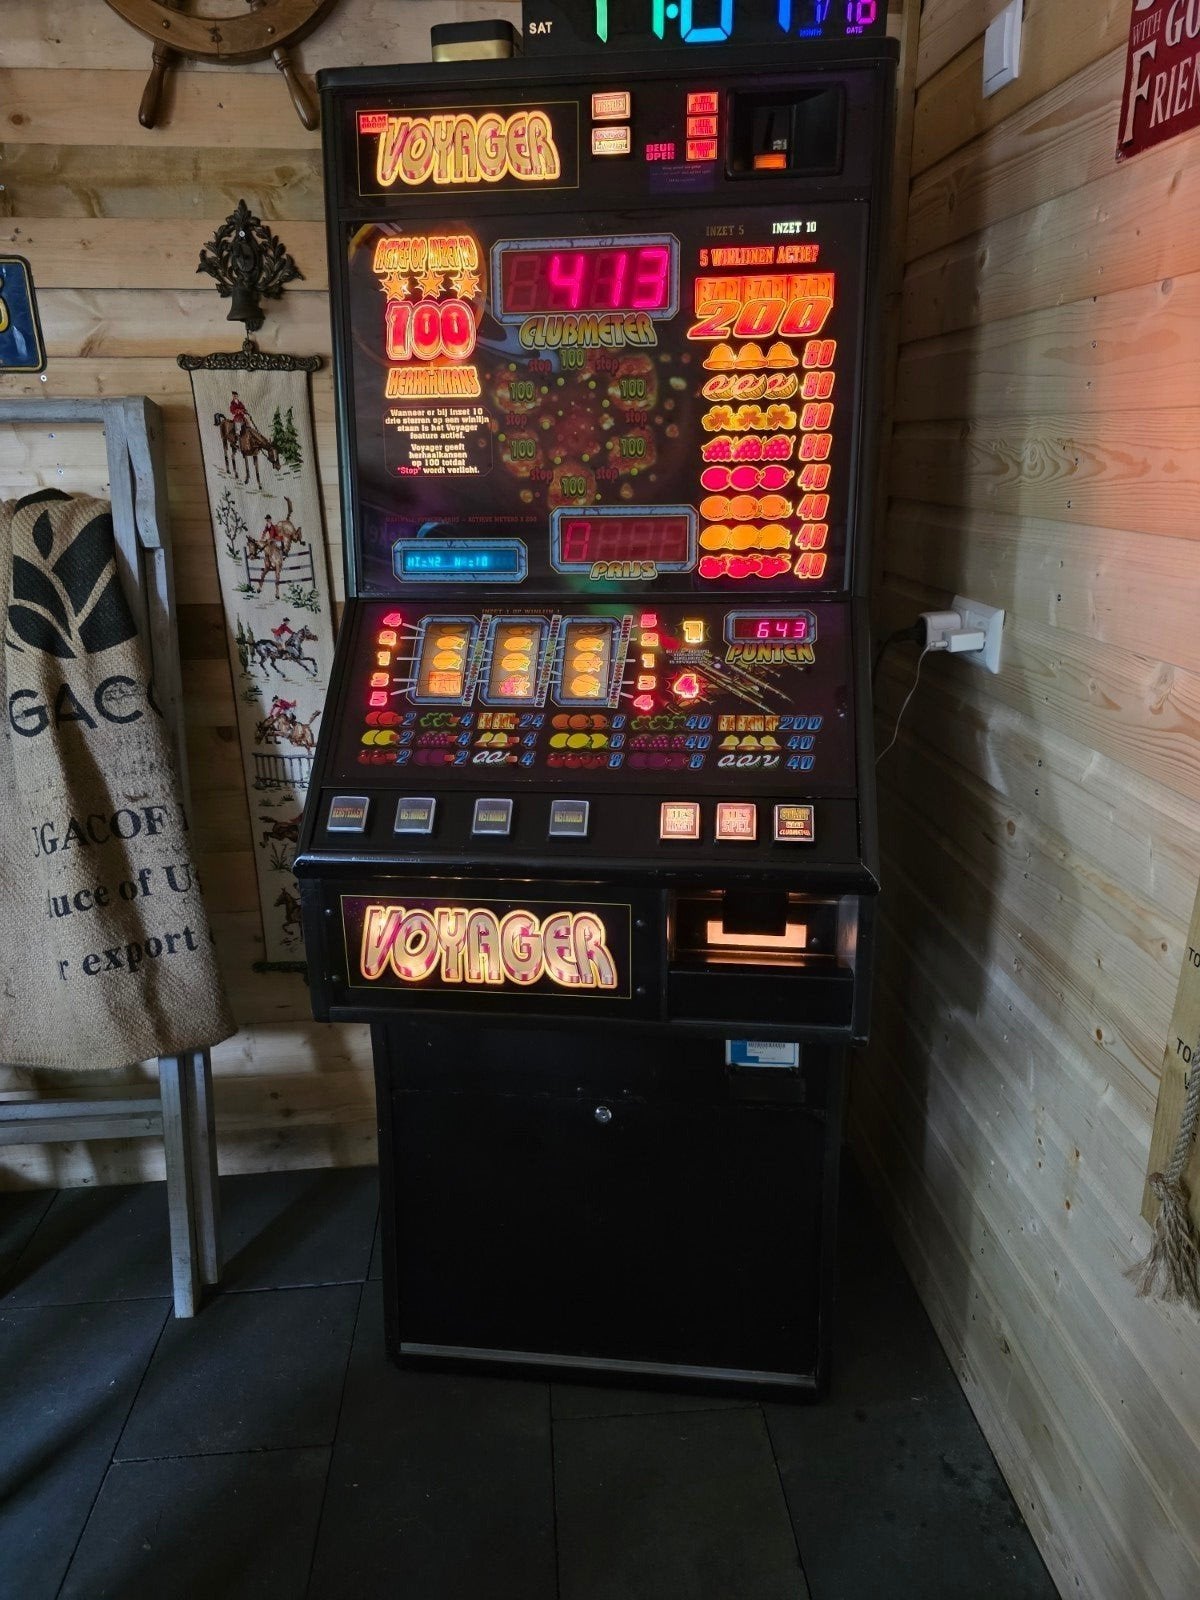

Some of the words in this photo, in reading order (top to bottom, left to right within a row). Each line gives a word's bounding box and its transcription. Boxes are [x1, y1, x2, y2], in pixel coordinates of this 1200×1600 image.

[528, 21, 553, 35] SAT
[846, 26, 863, 35] DATE
[1133, 9, 1163, 46] WITH
[361, 122, 387, 130] GROUP
[378, 111, 560, 186] VOYAGER
[646, 143, 675, 152] DEUR
[646, 151, 675, 160] OPEN
[706, 225, 734, 236] INZET
[738, 225, 745, 236] 5
[772, 222, 802, 234] INZET
[806, 221, 817, 233] 10
[700, 249, 708, 267] 5
[776, 245, 819, 264] ACTIEF
[552, 250, 668, 308] 413
[687, 297, 833, 340] 200
[386, 299, 476, 360] 100
[520, 313, 657, 349] CLUBMETER
[528, 358, 552, 374] stop
[560, 349, 585, 370] 100
[595, 356, 619, 375] stop
[510, 381, 534, 401] 100
[620, 379, 645, 399] 100
[385, 417, 401, 425] drie
[462, 416, 490, 425] winlijn
[390, 409, 425, 417] Wanneer
[437, 408, 448, 418] bij
[450, 408, 470, 416] inzet
[506, 412, 527, 430] stop
[625, 410, 647, 429] stop
[422, 424, 429, 432] is
[431, 424, 444, 432] het
[446, 424, 478, 433] Voyager
[408, 451, 468, 459] herhaalkansen
[411, 444, 442, 452] Voyager
[511, 440, 536, 461] 100
[620, 438, 645, 457] 100
[447, 466, 480, 474] verlicht.
[531, 467, 553, 482] stop
[595, 467, 618, 482] stop
[798, 464, 831, 491] 40
[561, 476, 586, 497] 100
[797, 494, 830, 520] 40
[795, 523, 829, 550] 40
[590, 561, 658, 580] PRIJS
[794, 553, 827, 579] 40
[383, 613, 402, 627] 4
[640, 614, 657, 628] 5
[683, 621, 703, 643] 1
[757, 622, 806, 638] 643
[641, 633, 658, 647] 2
[377, 651, 391, 666] 1
[641, 653, 655, 668] 1
[726, 644, 816, 664] PUNTEN
[637, 675, 656, 690] 3
[674, 674, 699, 698] 4
[369, 691, 387, 706] 5
[633, 694, 653, 710] 4
[402, 712, 416, 727] 2
[460, 712, 474, 727] 4
[519, 712, 545, 728] 24
[685, 714, 712, 730] 40
[778, 716, 823, 732] 200
[399, 730, 415, 746] 2
[457, 731, 472, 747] 4
[522, 732, 538, 749] 4
[685, 734, 712, 750] 40
[787, 735, 815, 750] 40
[395, 750, 412, 766] 2
[452, 751, 469, 766] 2
[520, 751, 535, 768] 4
[786, 755, 815, 771] 40
[780, 808, 810, 821] START
[722, 821, 751, 833] SPEL
[48, 883, 110, 918] uce
[118, 868, 152, 901] of
[163, 863, 203, 897] U
[82, 926, 199, 977] export
[360, 906, 618, 988] VOYAGER
